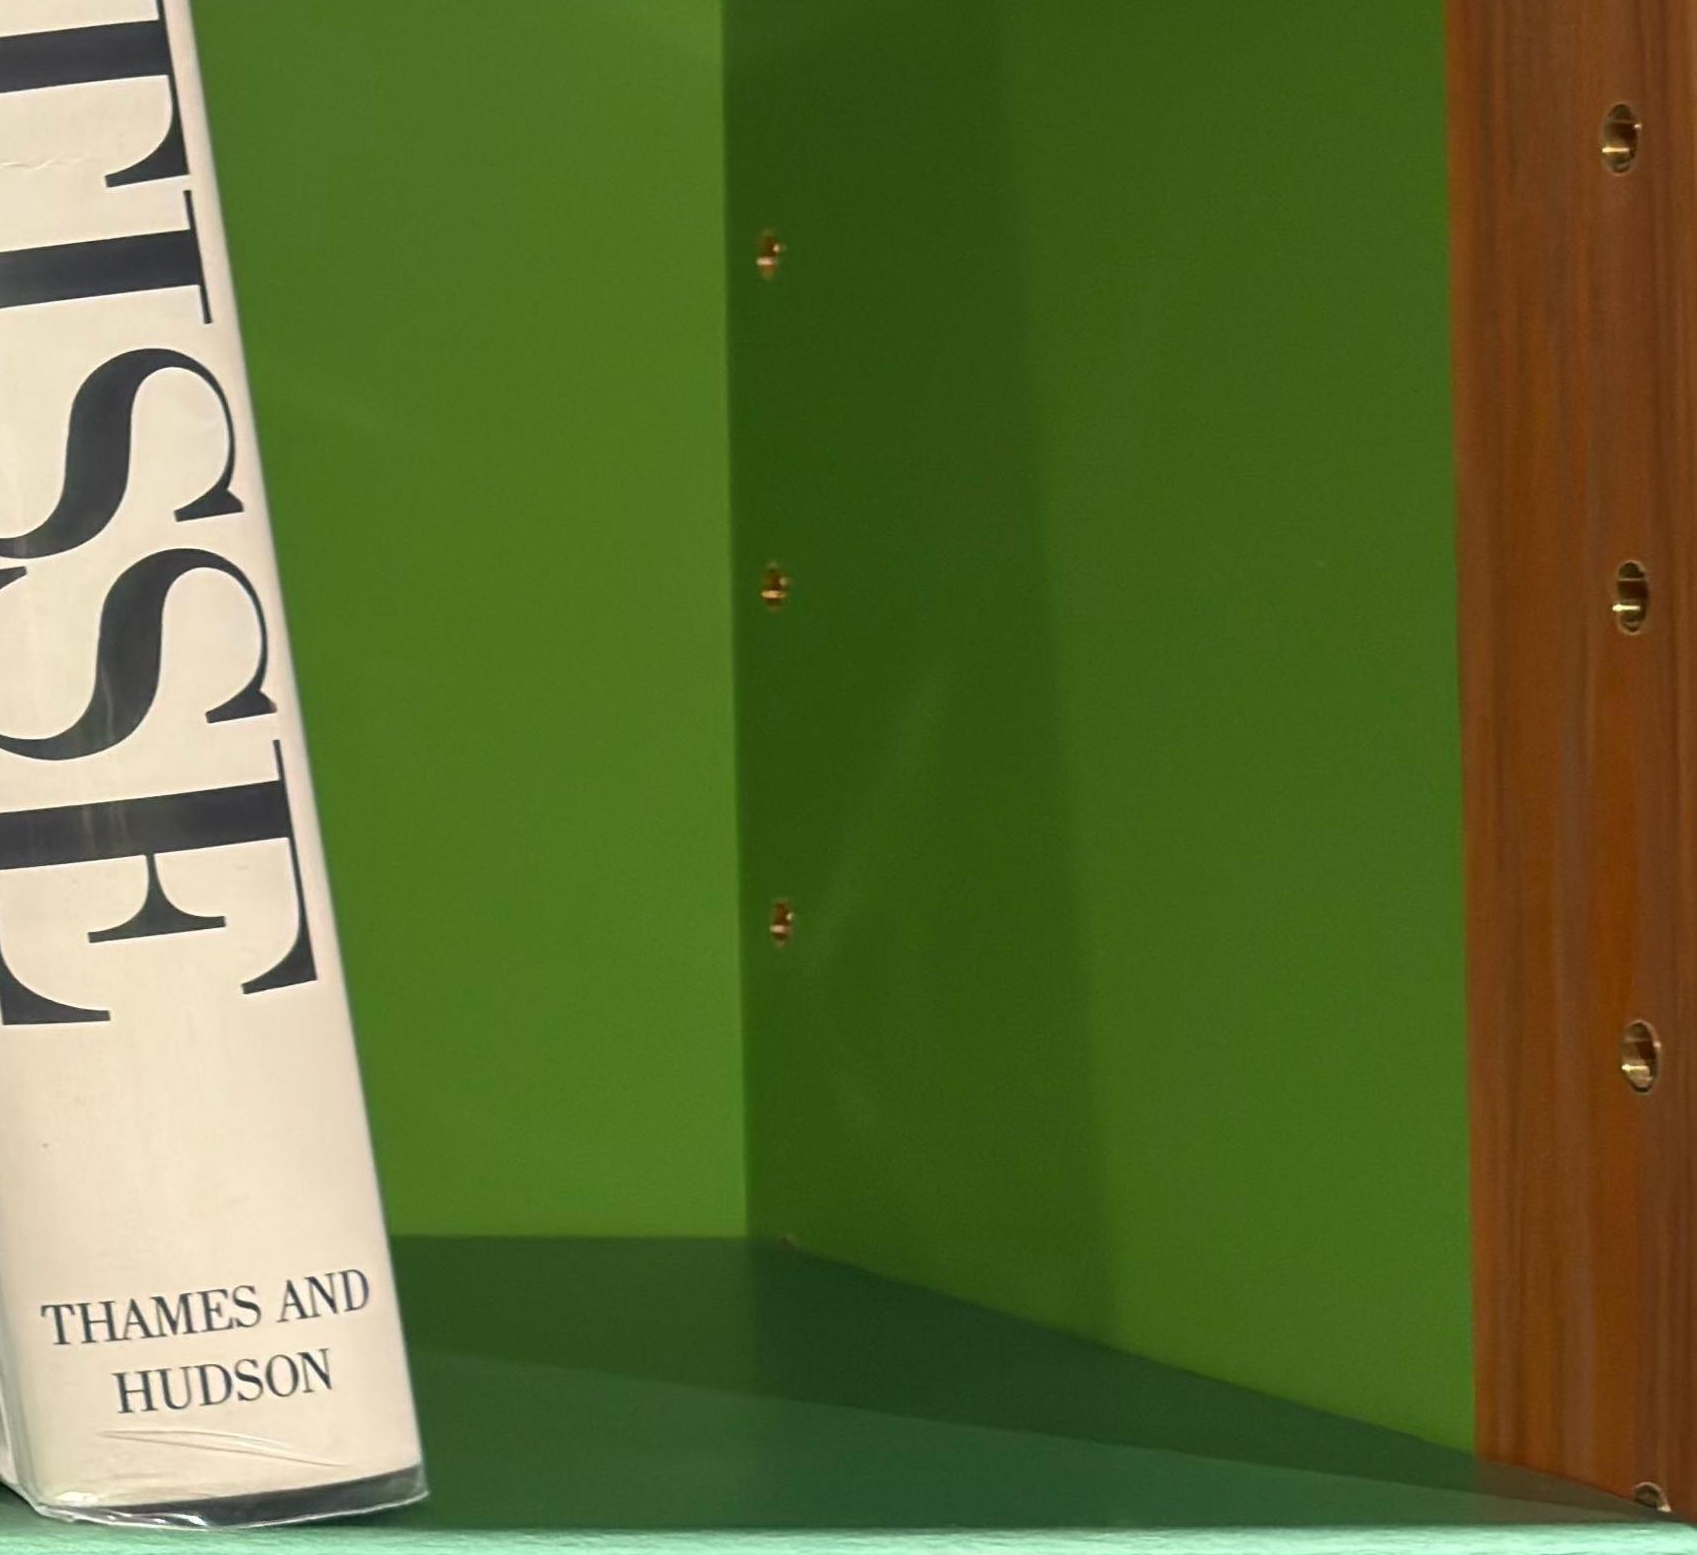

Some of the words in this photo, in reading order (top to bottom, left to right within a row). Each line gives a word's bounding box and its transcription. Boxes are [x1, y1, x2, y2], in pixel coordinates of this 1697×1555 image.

[41, 1282, 264, 1348] THAMES
[275, 1267, 373, 1322] AND
[113, 1346, 335, 1418] HUDSON
